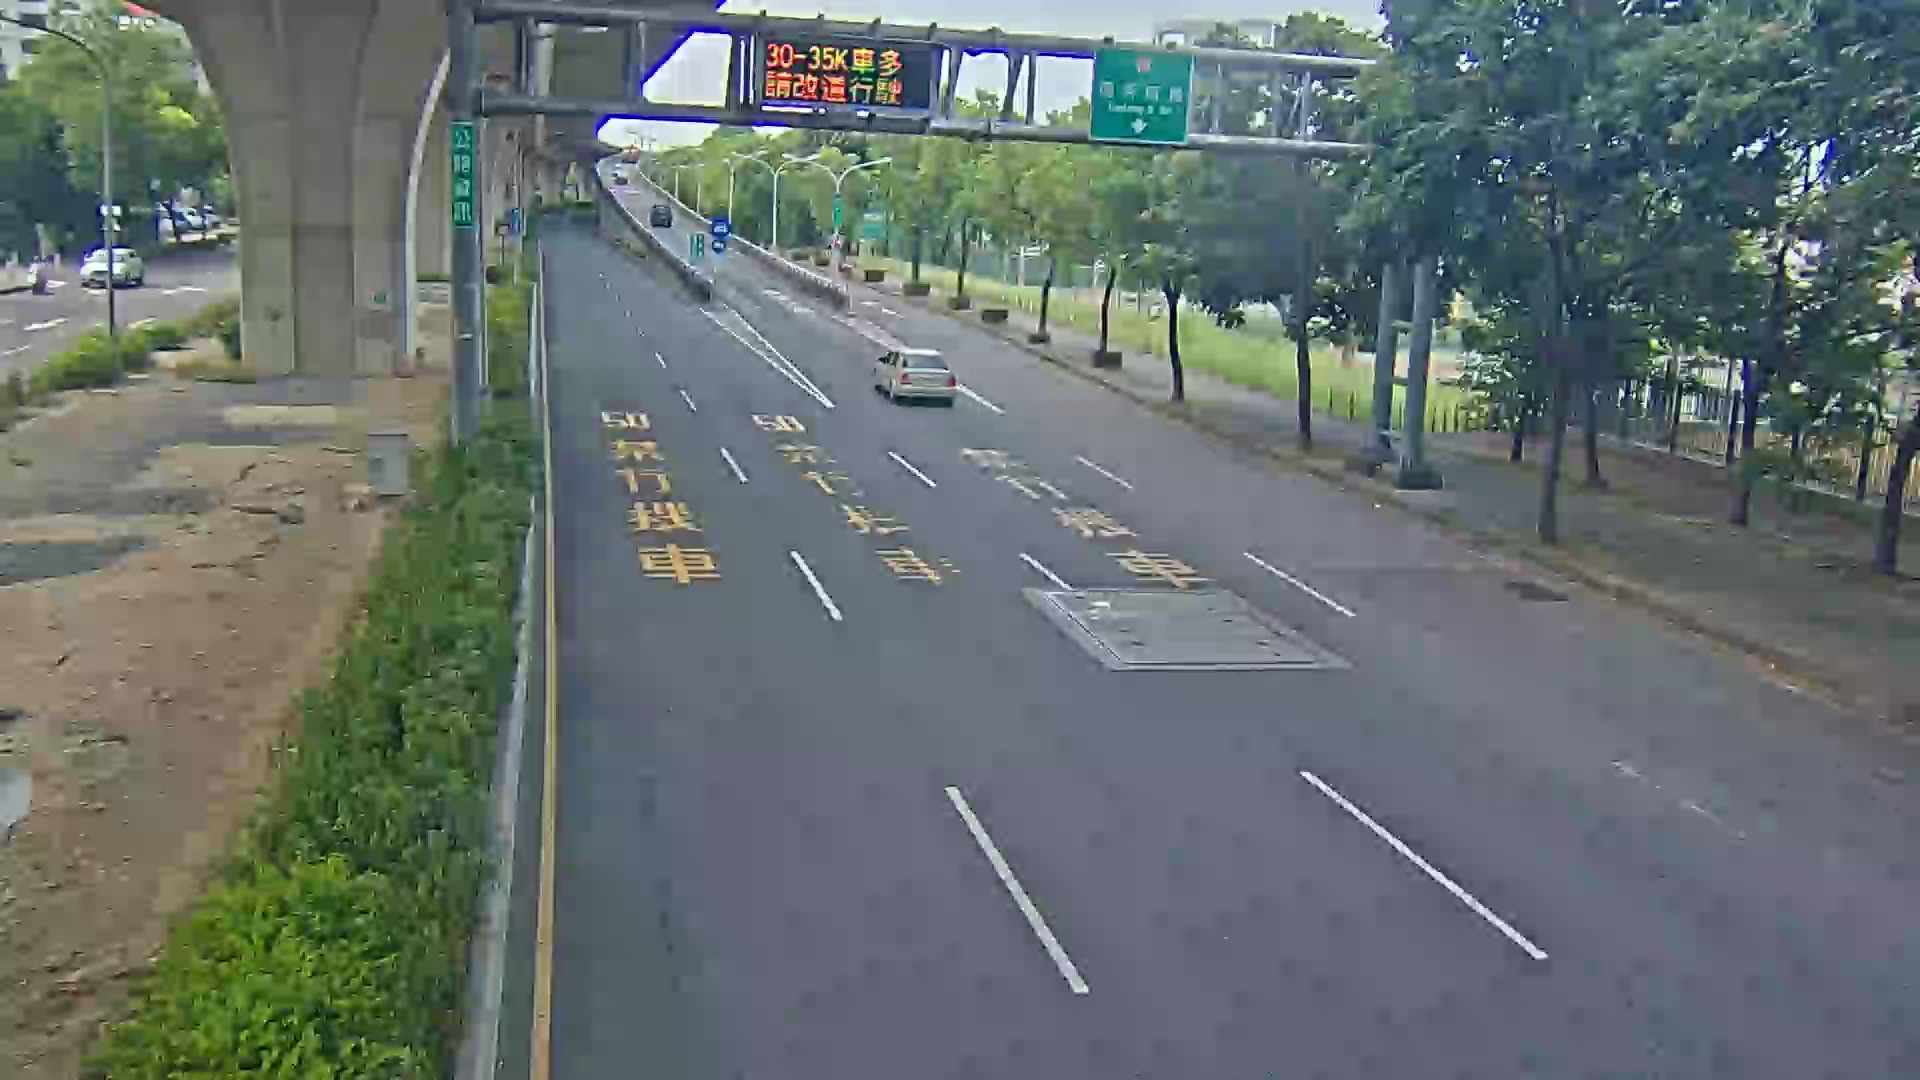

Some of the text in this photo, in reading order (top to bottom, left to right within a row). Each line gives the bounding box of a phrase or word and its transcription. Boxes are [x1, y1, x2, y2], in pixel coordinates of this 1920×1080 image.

[764, 69, 903, 107] 請改道行駛
[601, 411, 651, 430] 50
[751, 413, 806, 433] 50
